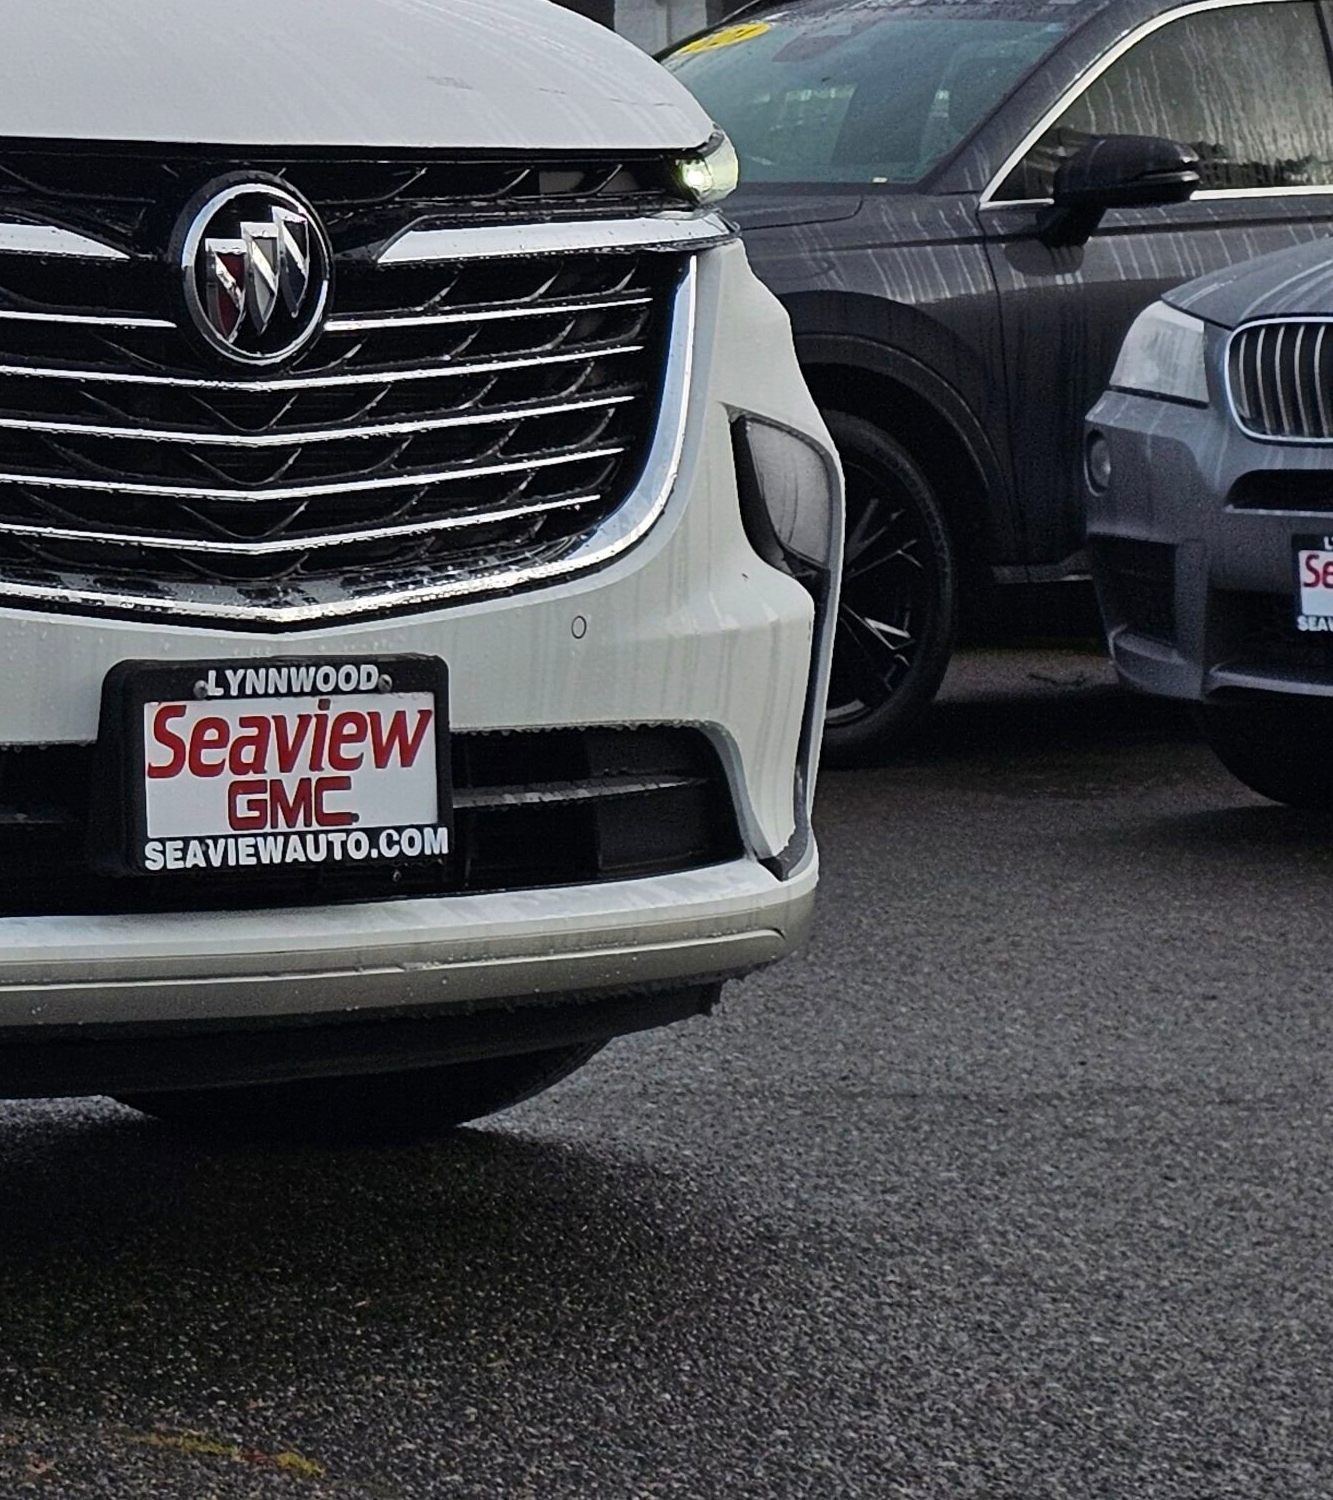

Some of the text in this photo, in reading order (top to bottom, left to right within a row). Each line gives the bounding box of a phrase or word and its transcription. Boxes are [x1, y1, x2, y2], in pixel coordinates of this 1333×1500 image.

[207, 664, 380, 697] LYNNWOOD
[147, 699, 433, 779] Seaview
[228, 775, 356, 831] GMC
[144, 827, 449, 871] SEAVIEWAUTO.COM
